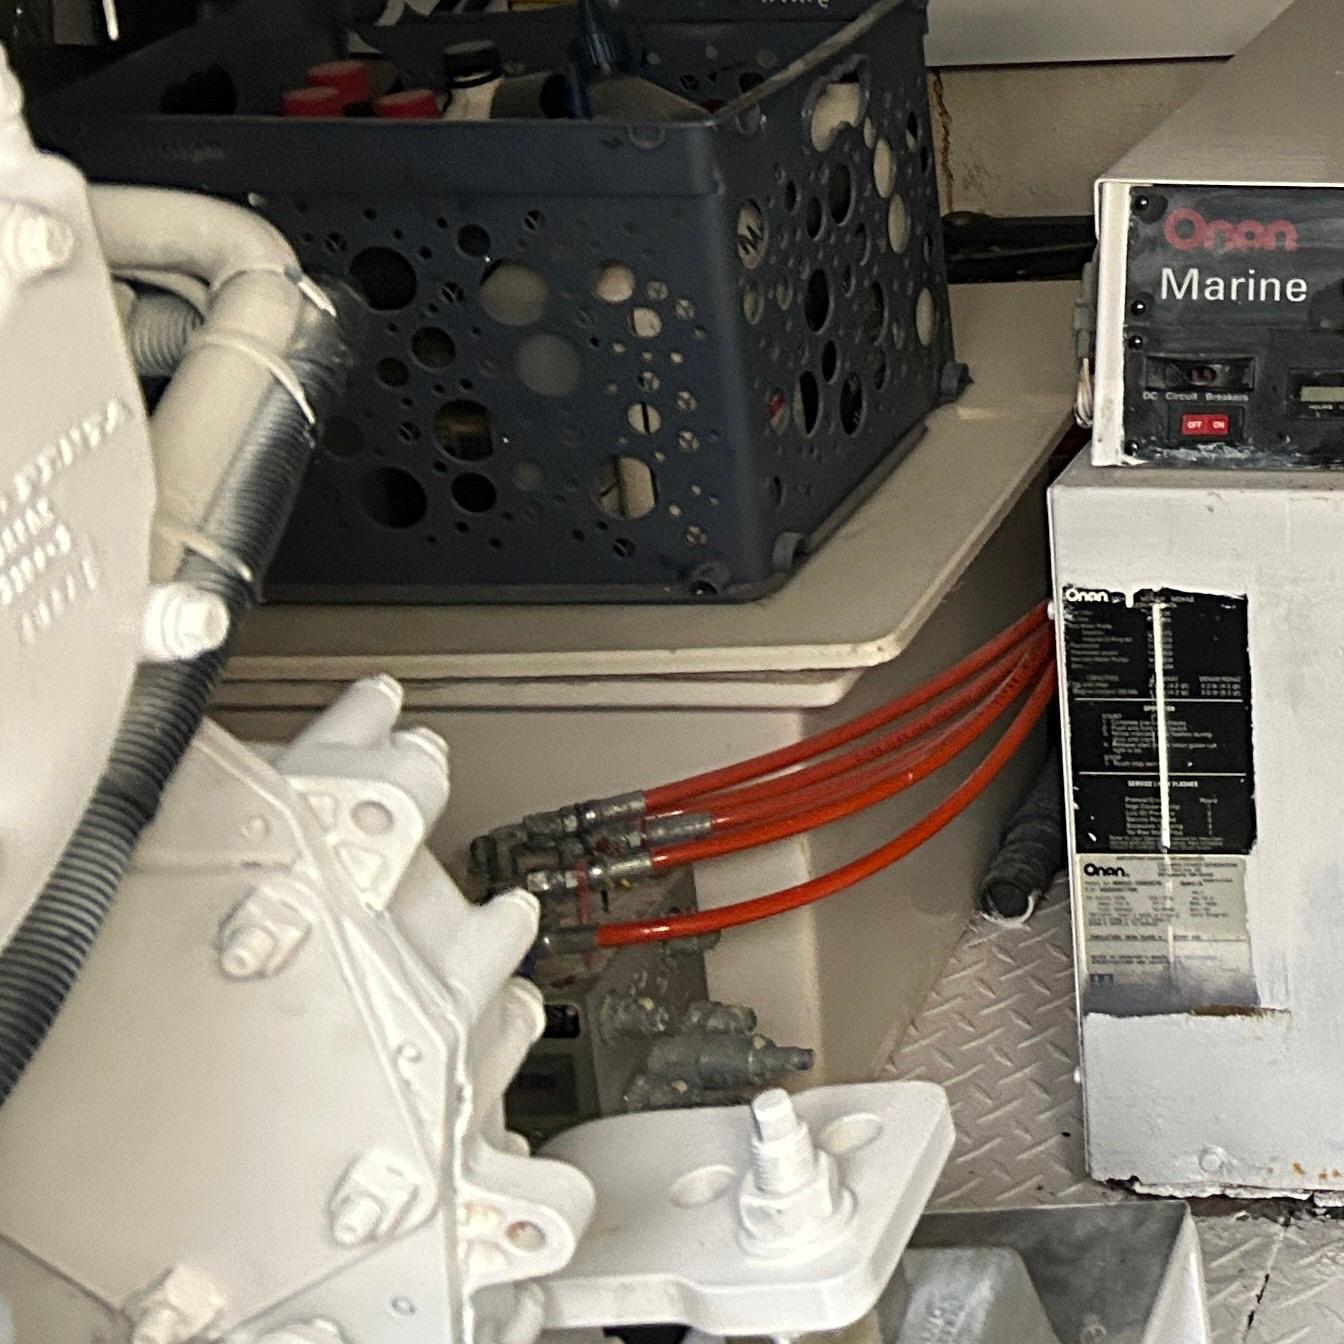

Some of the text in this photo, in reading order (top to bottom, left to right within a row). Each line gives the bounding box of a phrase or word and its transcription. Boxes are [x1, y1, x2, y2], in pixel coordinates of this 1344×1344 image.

[1164, 207, 1298, 253] Onan
[1160, 267, 1308, 304] Marine
[1143, 392, 1249, 402] DC Circuit Breakers
[1187, 421, 1225, 429] OFF ON
[1065, 588, 1110, 603] Onan
[1083, 862, 1126, 877] Onan
